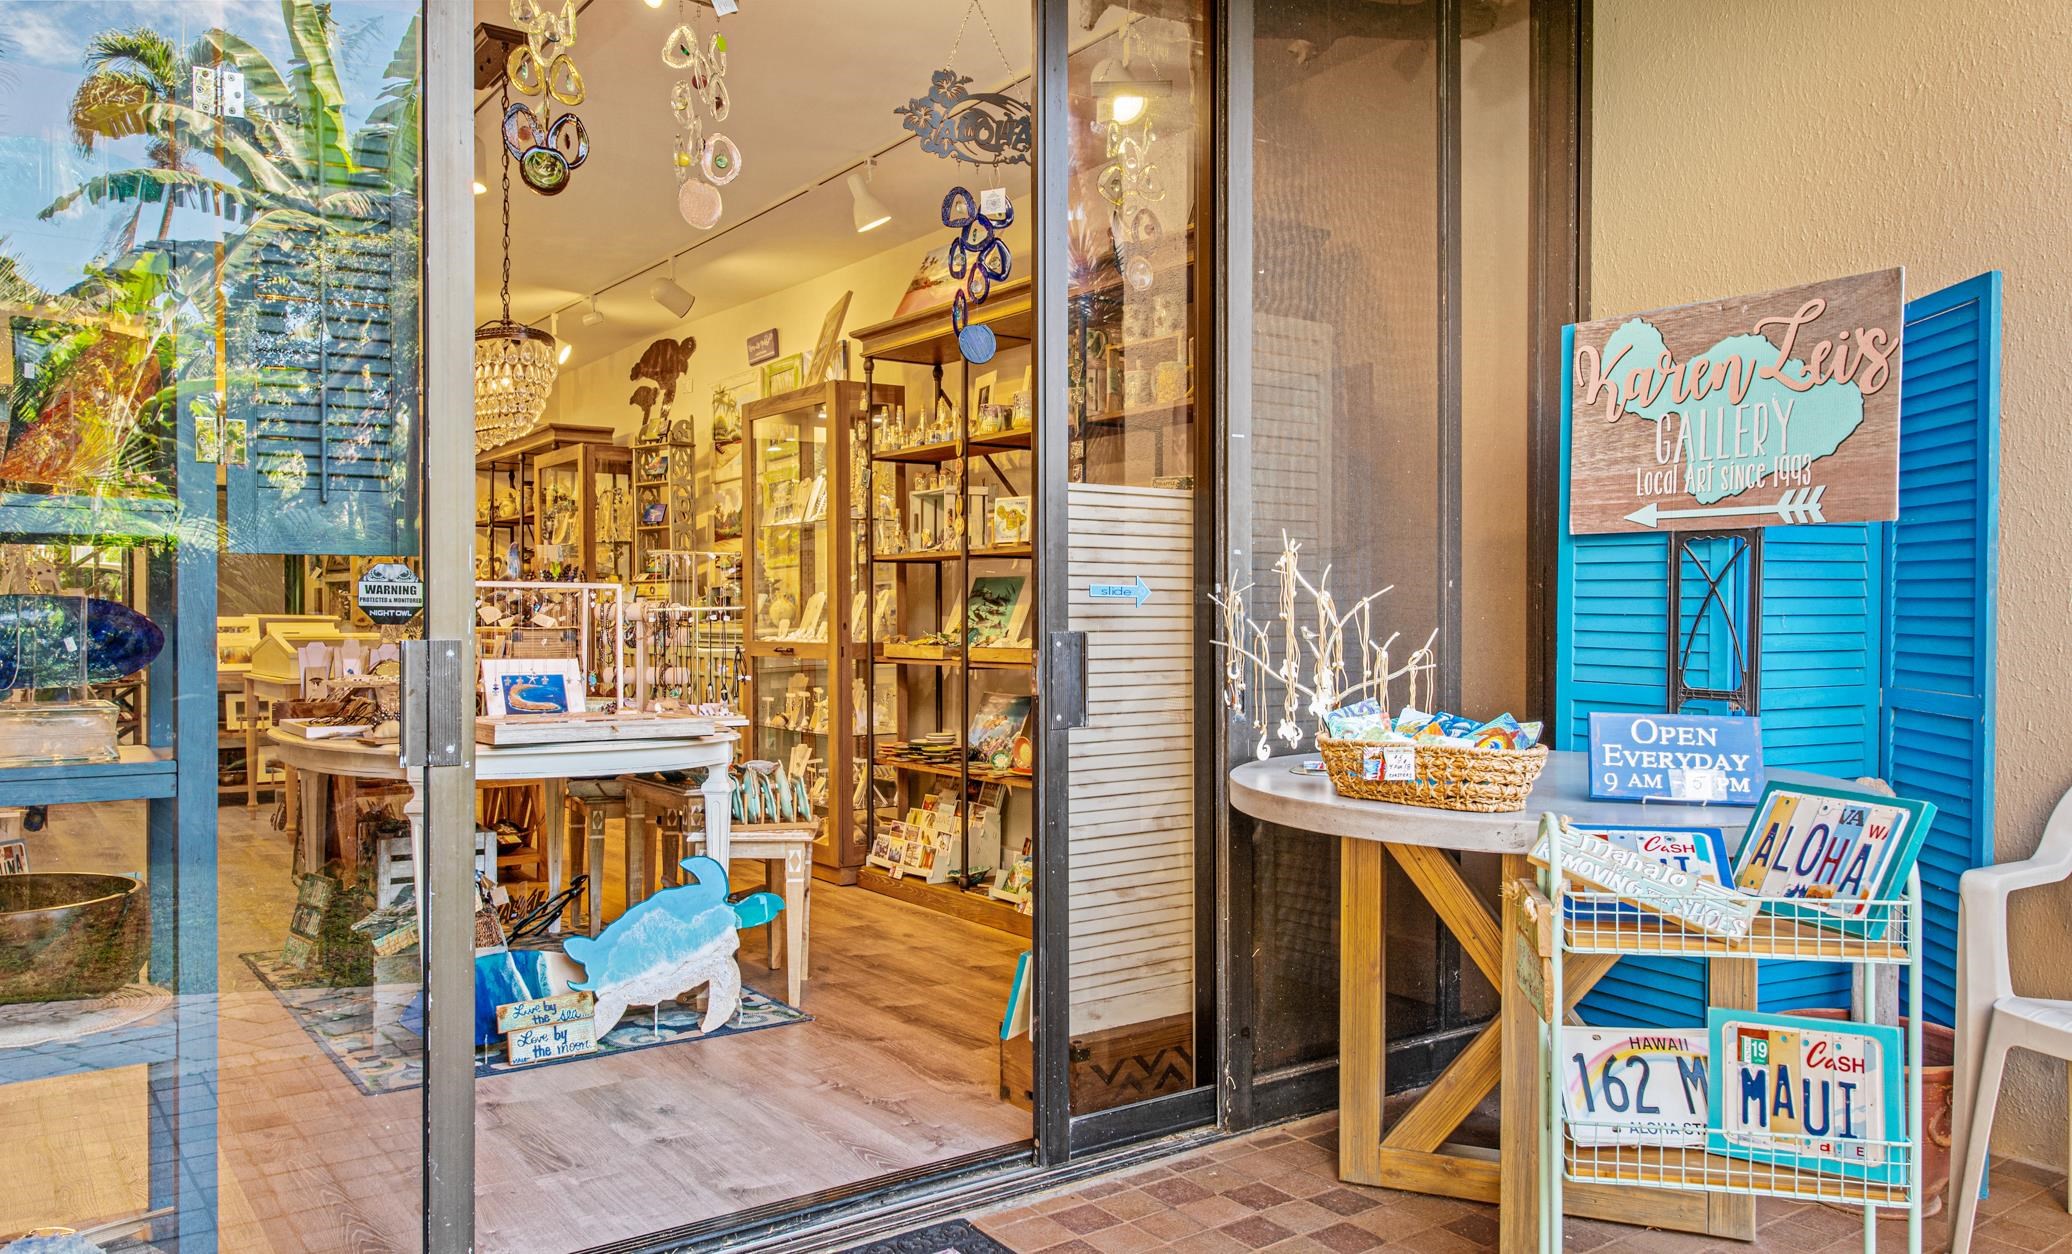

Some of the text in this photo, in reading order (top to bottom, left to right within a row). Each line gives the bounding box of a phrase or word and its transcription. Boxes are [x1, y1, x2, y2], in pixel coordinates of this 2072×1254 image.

[1576, 344, 1757, 423] Karen
[1656, 397, 1796, 465] GALLERY
[1636, 453, 1813, 497] Local Art since 1993
[364, 584, 417, 595] WARNING
[1101, 585, 1132, 596] slide
[394, 596, 423, 604] MONITORED
[395, 609, 412, 617] OWL
[1631, 719, 1719, 747] OPEN
[1602, 743, 1750, 772] EVERYDAY
[1604, 772, 1618, 792] 9
[1628, 773, 1663, 789] AM
[1716, 777, 1751, 792] PM
[1838, 808, 1865, 827] VA
[1751, 822, 1873, 896] ALOHA
[512, 1001, 557, 1019] Live by
[532, 1014, 551, 1025] the
[554, 1025, 568, 1045] by
[1629, 1036, 1689, 1051] HAWAII
[533, 1045, 552, 1059] the
[1751, 1040, 1768, 1058] 19
[1572, 1052, 1661, 1115] 162
[1741, 1063, 1858, 1140] MAUI
